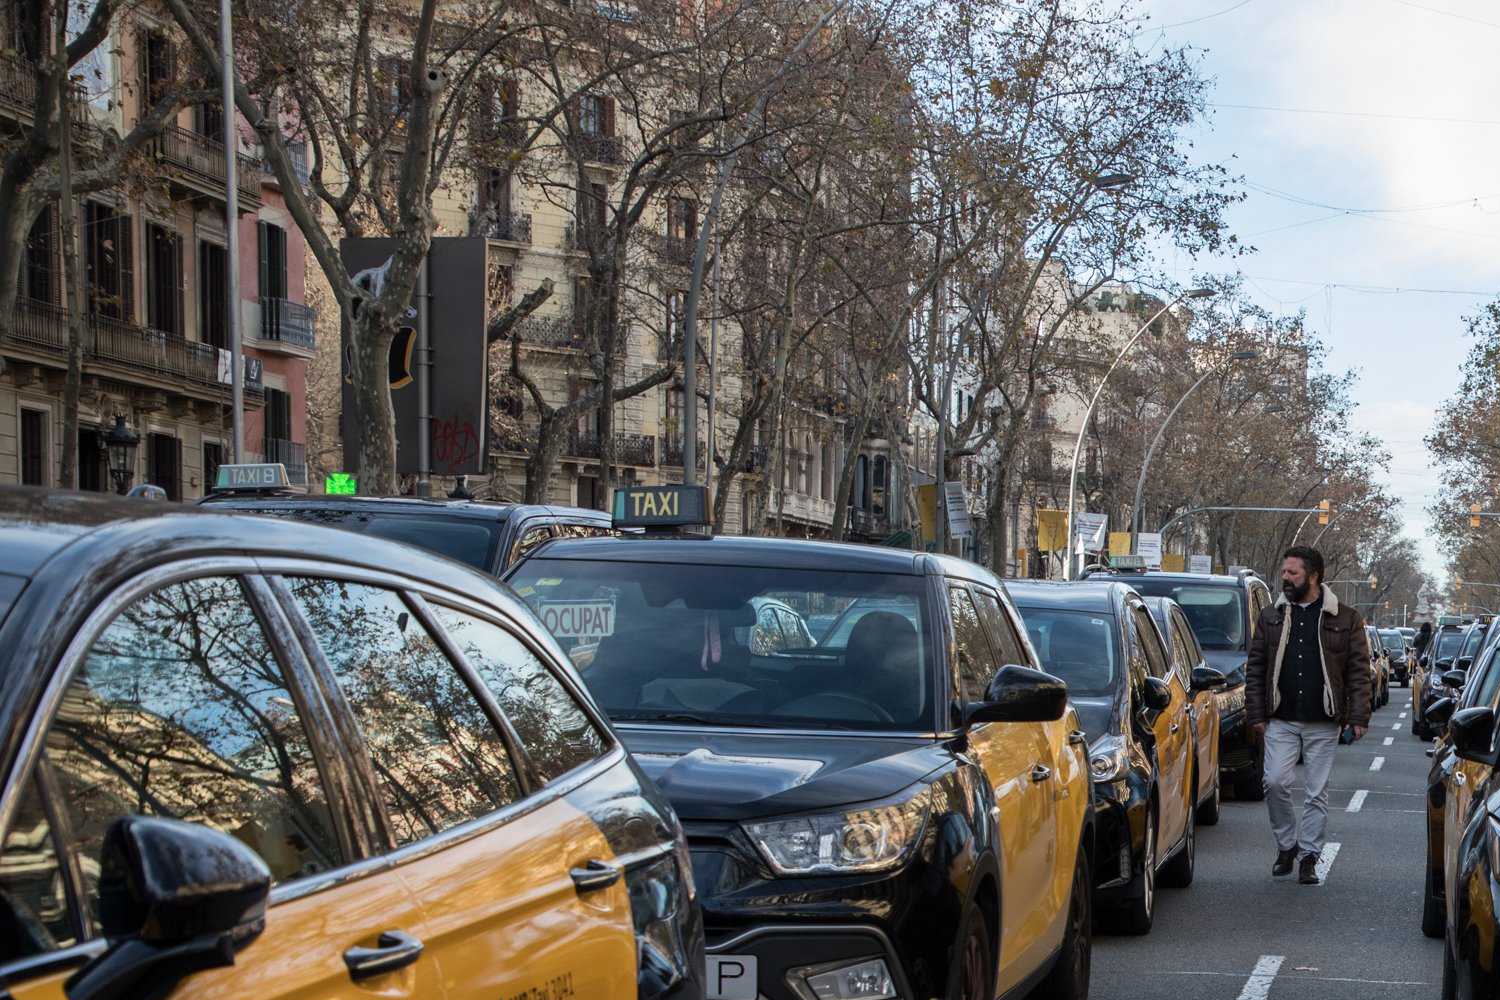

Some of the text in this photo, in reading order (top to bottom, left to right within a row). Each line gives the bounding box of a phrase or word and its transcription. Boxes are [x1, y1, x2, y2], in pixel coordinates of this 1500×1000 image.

[231, 468, 260, 484] TAXI
[629, 491, 679, 518] TAXI
[543, 606, 612, 635] OCUPAT
